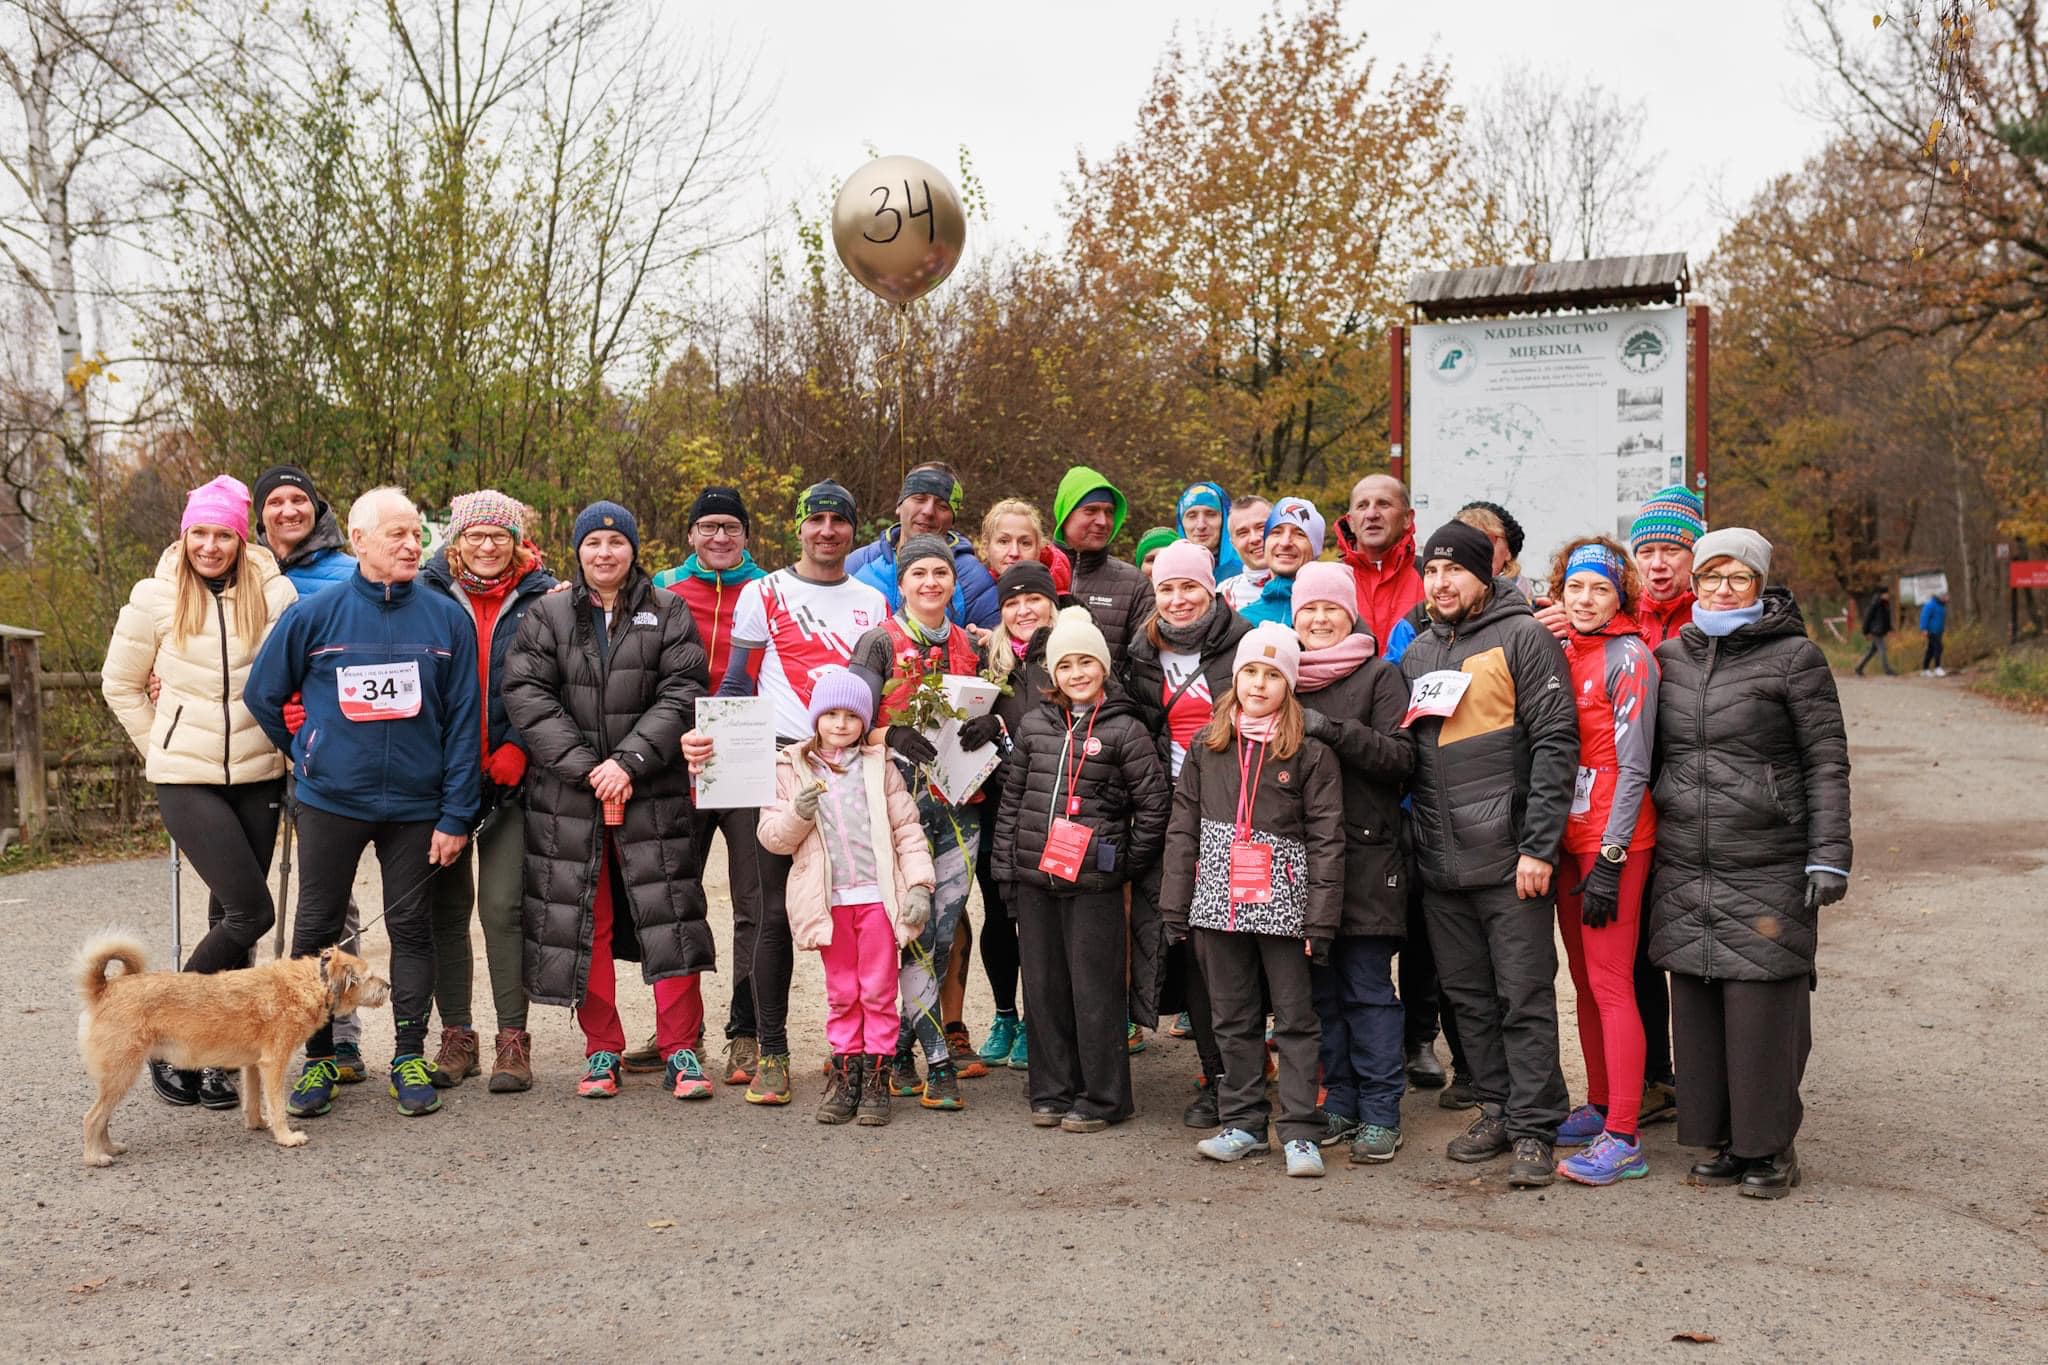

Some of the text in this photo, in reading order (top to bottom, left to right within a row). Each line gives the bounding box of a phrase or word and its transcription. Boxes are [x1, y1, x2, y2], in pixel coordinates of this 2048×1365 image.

[863, 179, 935, 244] 34
[1484, 321, 1609, 340] NADLEŚNICTWO
[1509, 343, 1582, 360] MIĘKINIA
[362, 678, 398, 701] 34
[1417, 682, 1444, 703] 34
